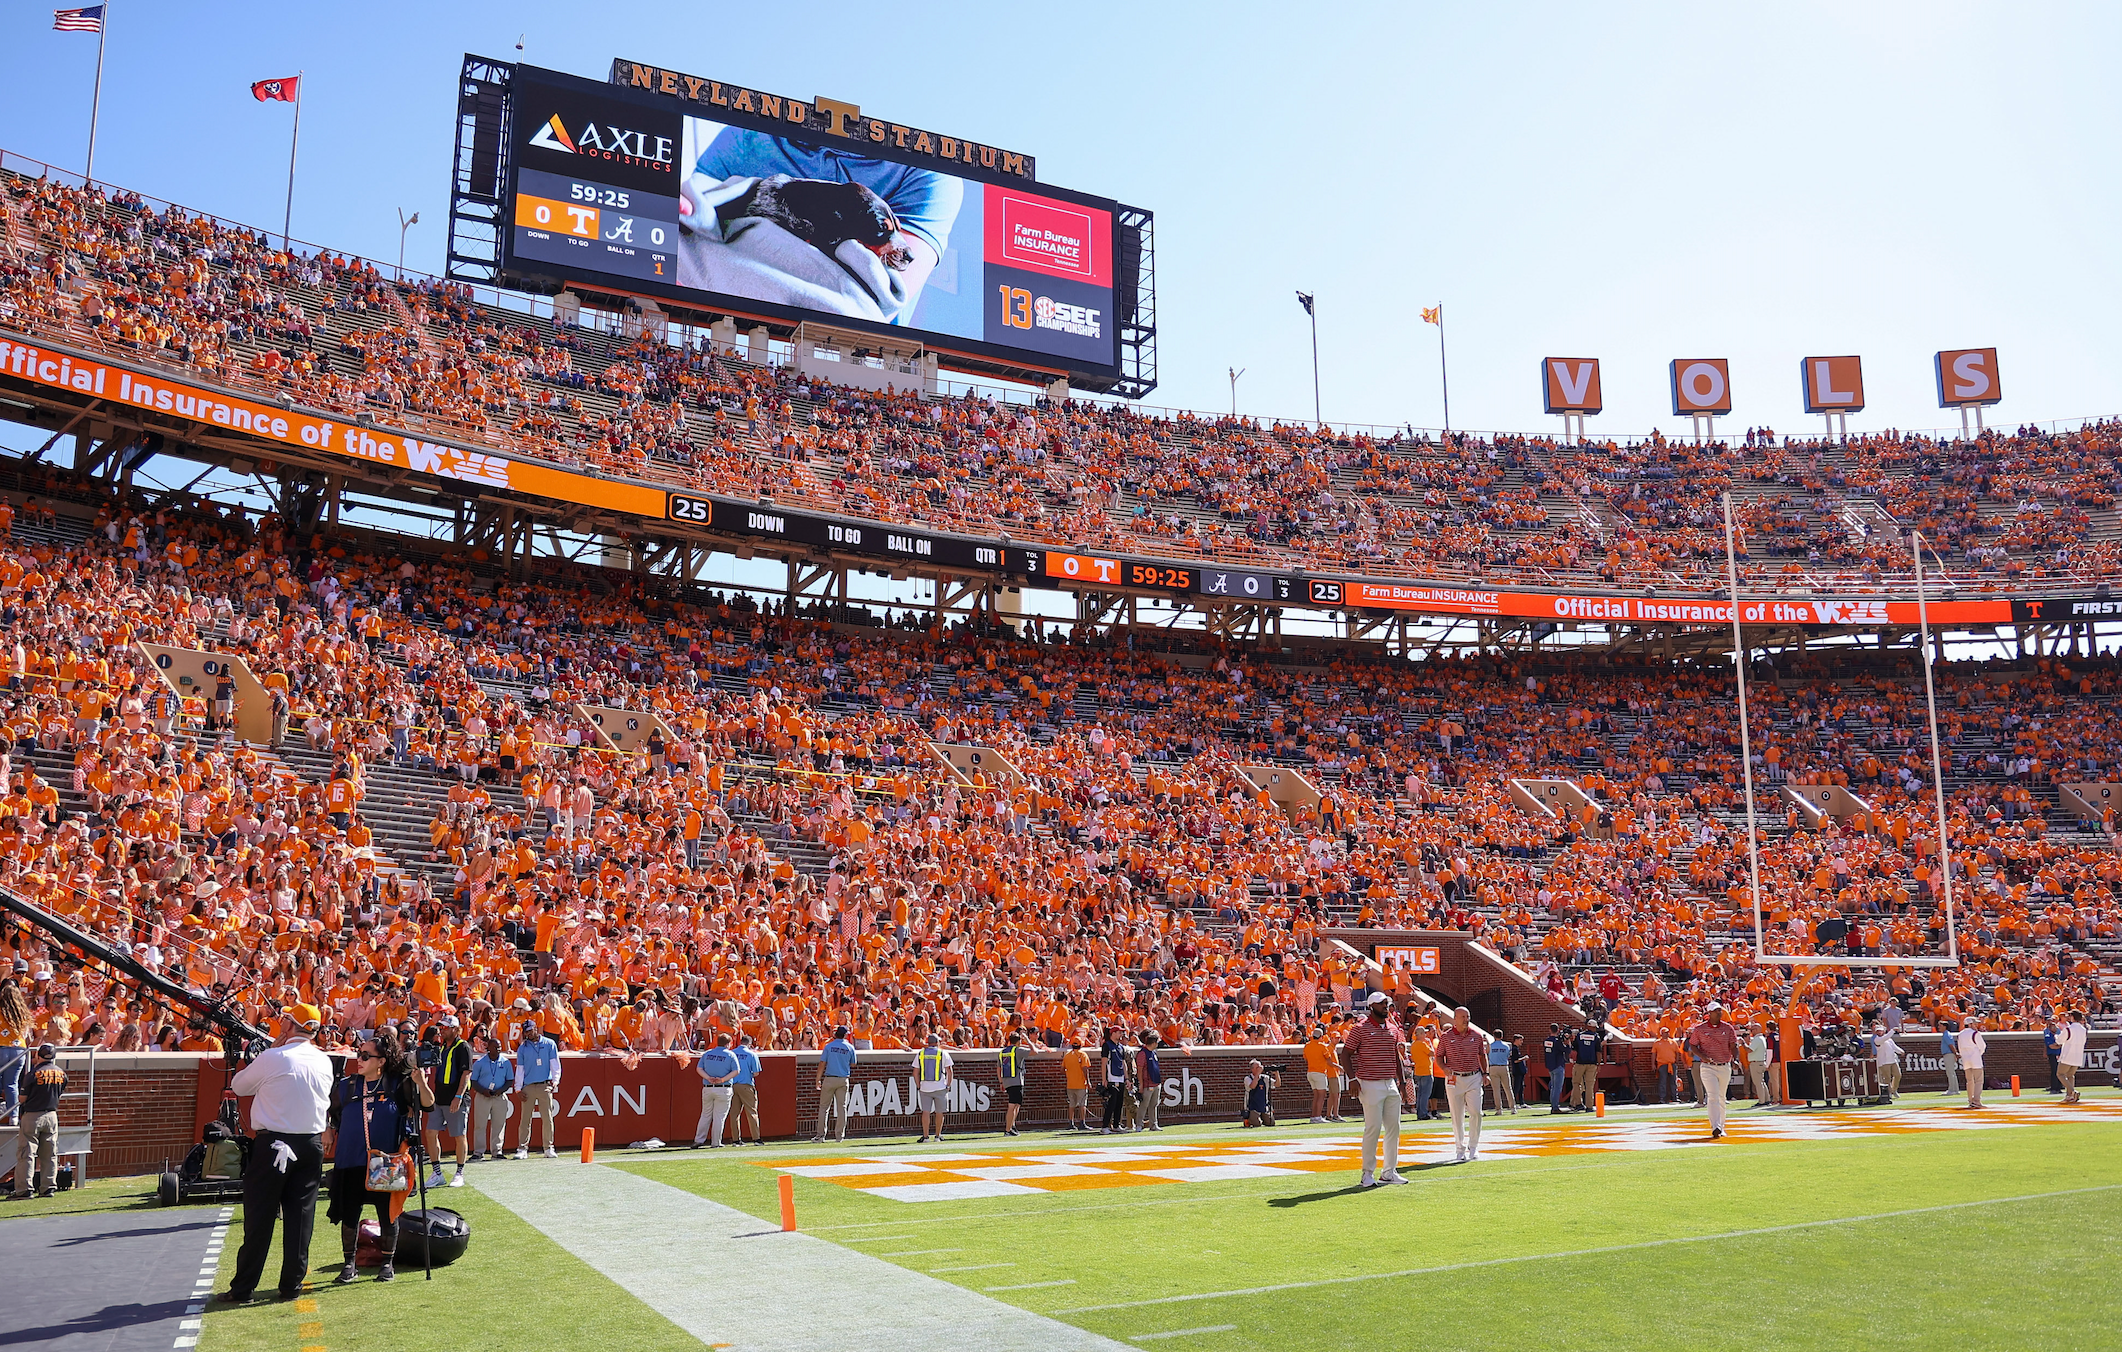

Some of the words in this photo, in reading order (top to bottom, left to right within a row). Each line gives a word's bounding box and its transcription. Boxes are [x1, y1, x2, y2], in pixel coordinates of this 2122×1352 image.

[631, 64, 805, 124] NEYLAND
[815, 96, 860, 138] T
[578, 122, 672, 164] AXLE
[869, 120, 1024, 175] STADIUM
[579, 146, 671, 172] LOGISTICS
[570, 183, 630, 208] 59:25
[535, 206, 550, 224] 0
[568, 206, 595, 234] T
[528, 230, 550, 240] DOWN
[605, 216, 633, 242] A
[651, 228, 665, 245] 0
[1015, 224, 1042, 238] Farm
[1044, 230, 1080, 246] Bureau
[607, 246, 623, 254] BALL
[1014, 235, 1079, 258] INSURANCE
[654, 262, 664, 275] 1
[1054, 258, 1079, 268] Tennessee
[999, 284, 1032, 330] 13
[1036, 298, 1056, 318] SEC
[1055, 302, 1100, 327] SEC
[1036, 316, 1100, 339] CHAMPIONSHIPS
[119, 373, 289, 438] Insurance
[300, 422, 332, 448] of
[344, 428, 395, 461] the
[675, 500, 707, 520] 25
[748, 513, 784, 533] DOWN
[828, 525, 842, 542] TO
[844, 528, 861, 544] GO
[888, 535, 914, 553] BALL
[916, 539, 932, 556] ON
[976, 547, 996, 564] QTR
[1000, 550, 1005, 566] 1
[1025, 552, 1038, 560] TOL
[1028, 560, 1037, 572] 3
[1064, 557, 1079, 575] 0
[1094, 559, 1115, 582] T
[1132, 567, 1190, 588] 59:25
[1243, 576, 1259, 594] 0
[1277, 579, 1290, 587] TOL
[1280, 587, 1289, 598] 3
[1314, 584, 1339, 600] 25
[1362, 585, 1390, 597] Farm
[1392, 587, 1430, 599] Bureau
[1431, 590, 1498, 604] INSURANCE
[1554, 598, 1630, 618] Official
[1636, 601, 1735, 621] Insurance
[1745, 603, 1766, 621] of
[1773, 604, 1808, 621] the
[2026, 602, 2043, 618] T
[2072, 602, 2122, 614] FIRST
[162, 656, 166, 666] I
[208, 663, 215, 673] J
[629, 720, 636, 729] K
[973, 755, 978, 763] L
[332, 787, 345, 802] 16
[302, 904, 311, 915] 5
[779, 1006, 796, 1023] 16
[1050, 1005, 1057, 1017] 1
[508, 1022, 521, 1040] 16
[35, 1069, 64, 1078] EVENT
[37, 1076, 64, 1085] STAFF
[833, 1078, 902, 1117] APA
[905, 1076, 990, 1115] JHNS
